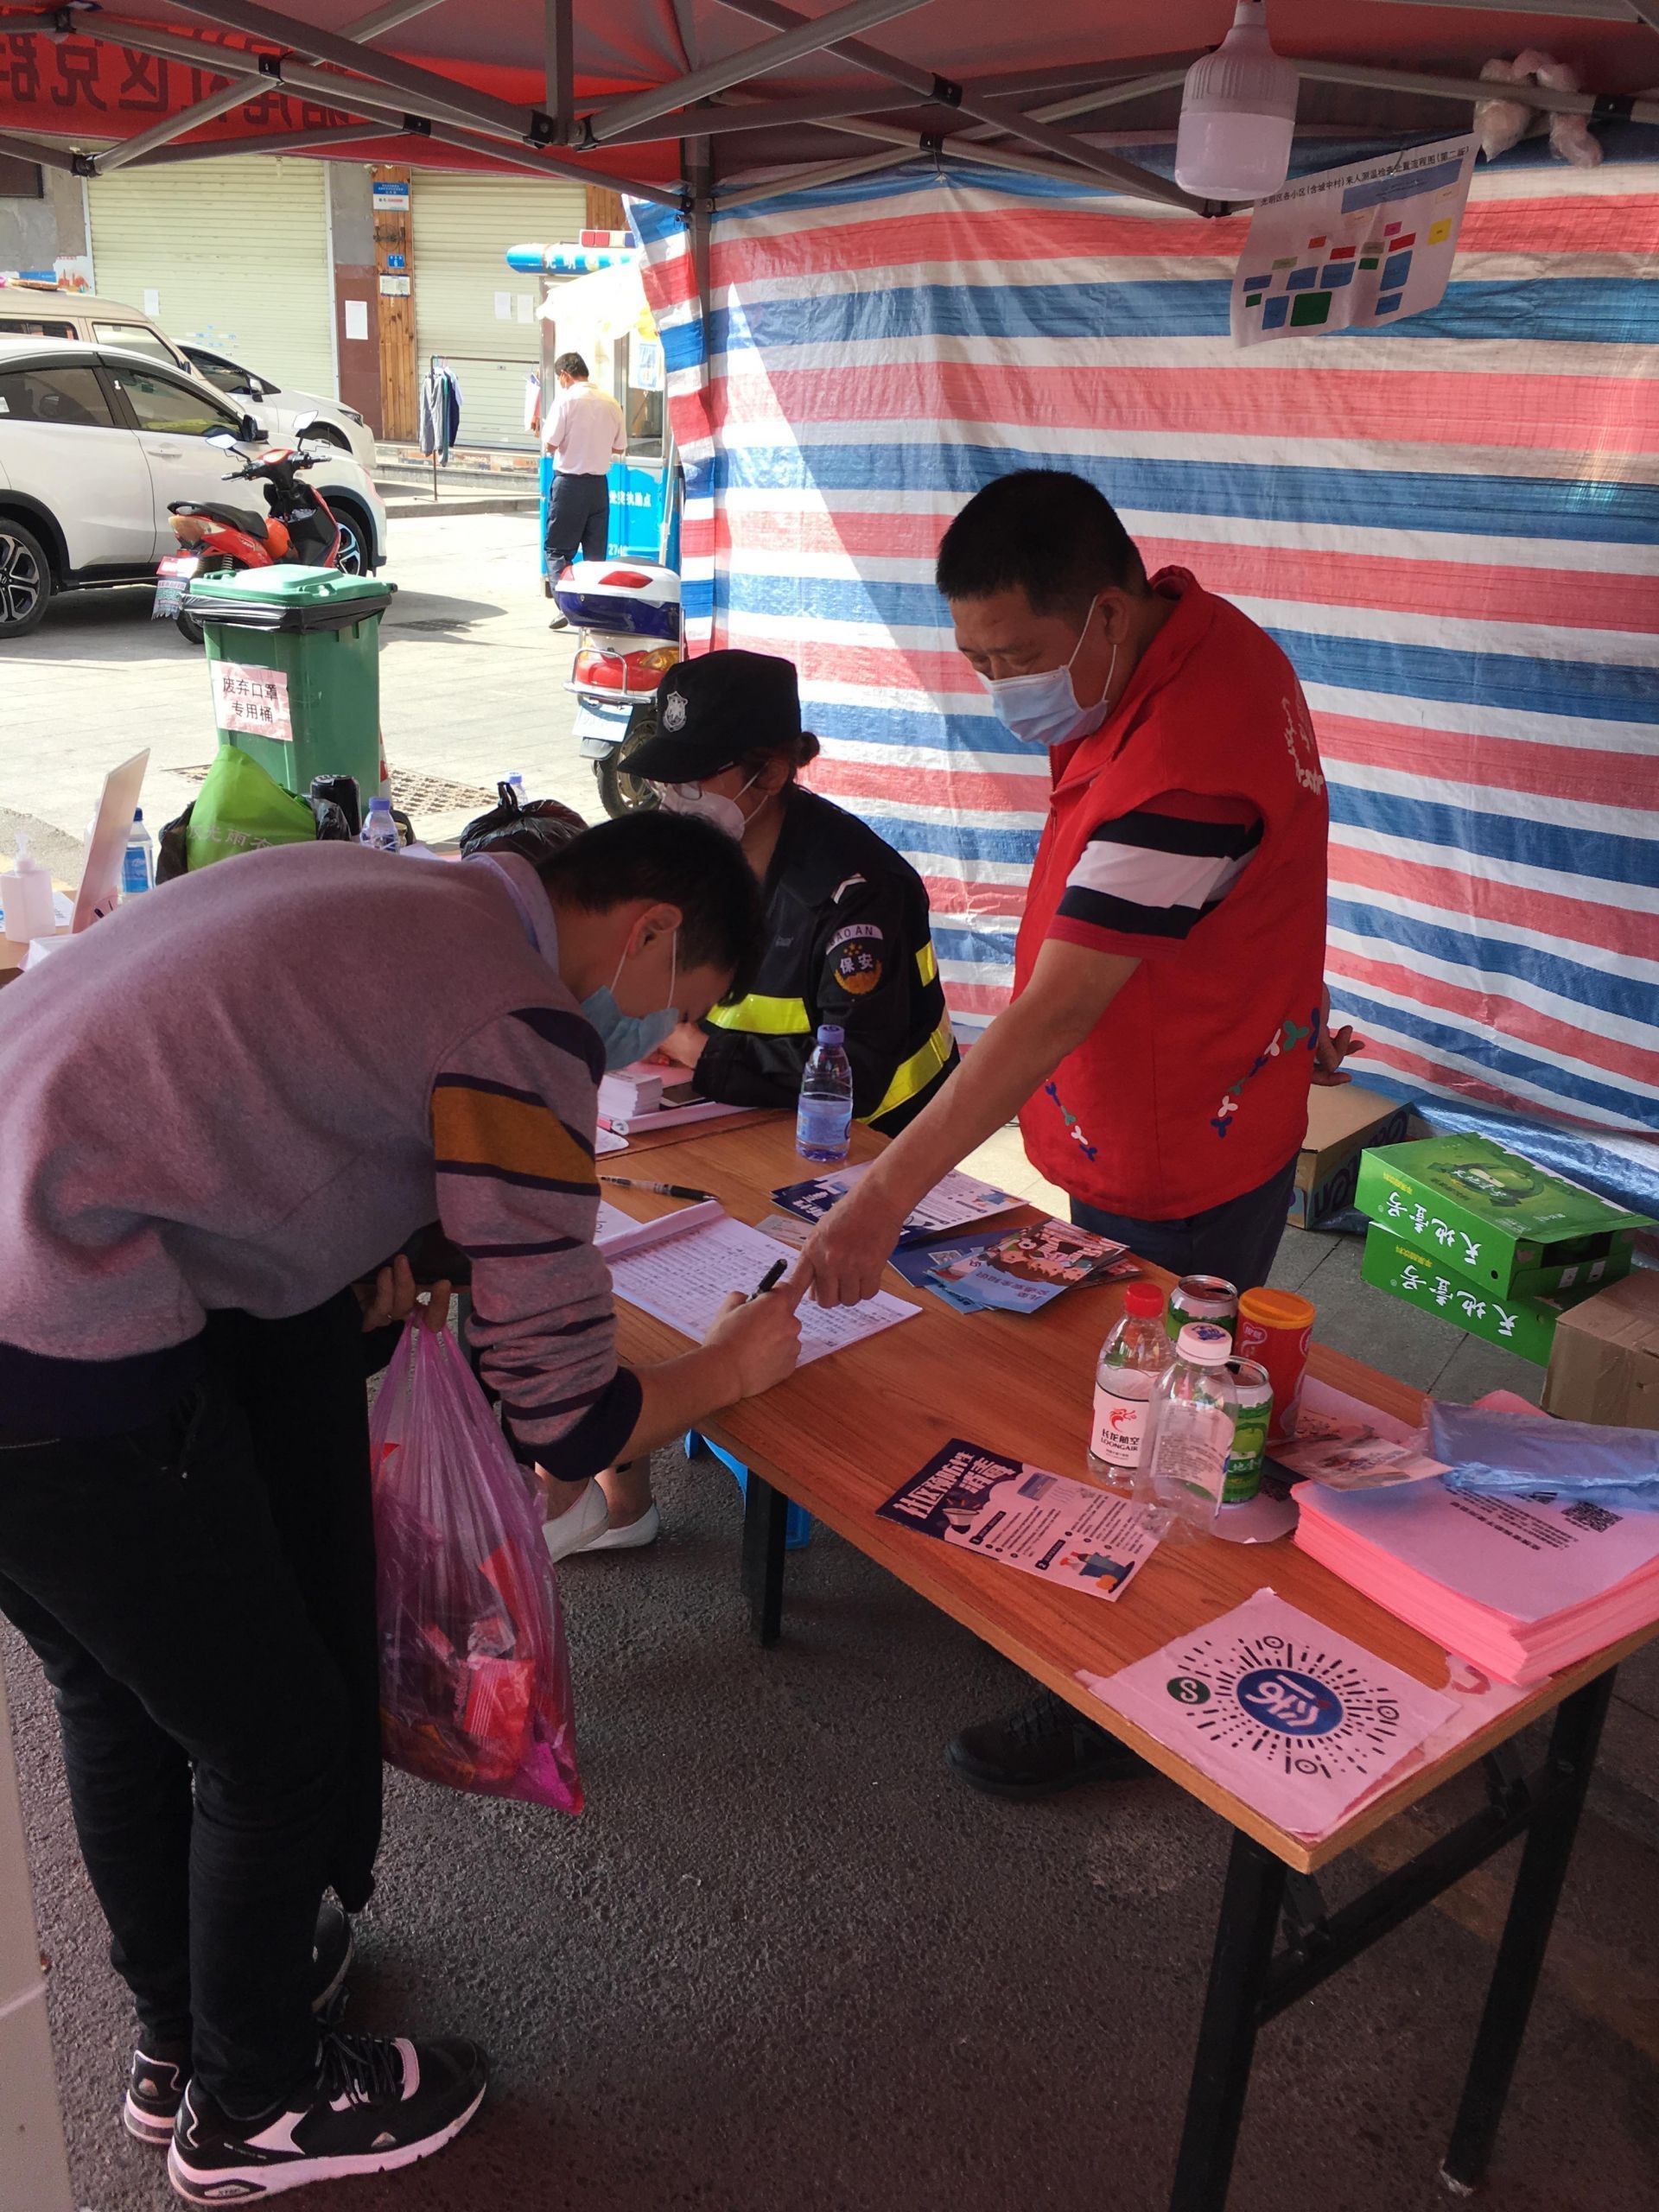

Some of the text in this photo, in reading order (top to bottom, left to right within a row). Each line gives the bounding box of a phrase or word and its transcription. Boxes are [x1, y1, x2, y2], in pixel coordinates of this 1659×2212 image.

[223, 677, 278, 701] 废弃口罩
[232, 701, 274, 723] 专用桶
[840, 953, 874, 975] 保安
[1386, 1192, 1482, 1266] 天地壹号
[1400, 1264, 1519, 1337] 天地壹号
[1100, 1437, 1138, 1452] LOONGAIR
[1102, 1428, 1140, 1446] 长龙航空
[959, 1457, 1017, 1494] 消毒
